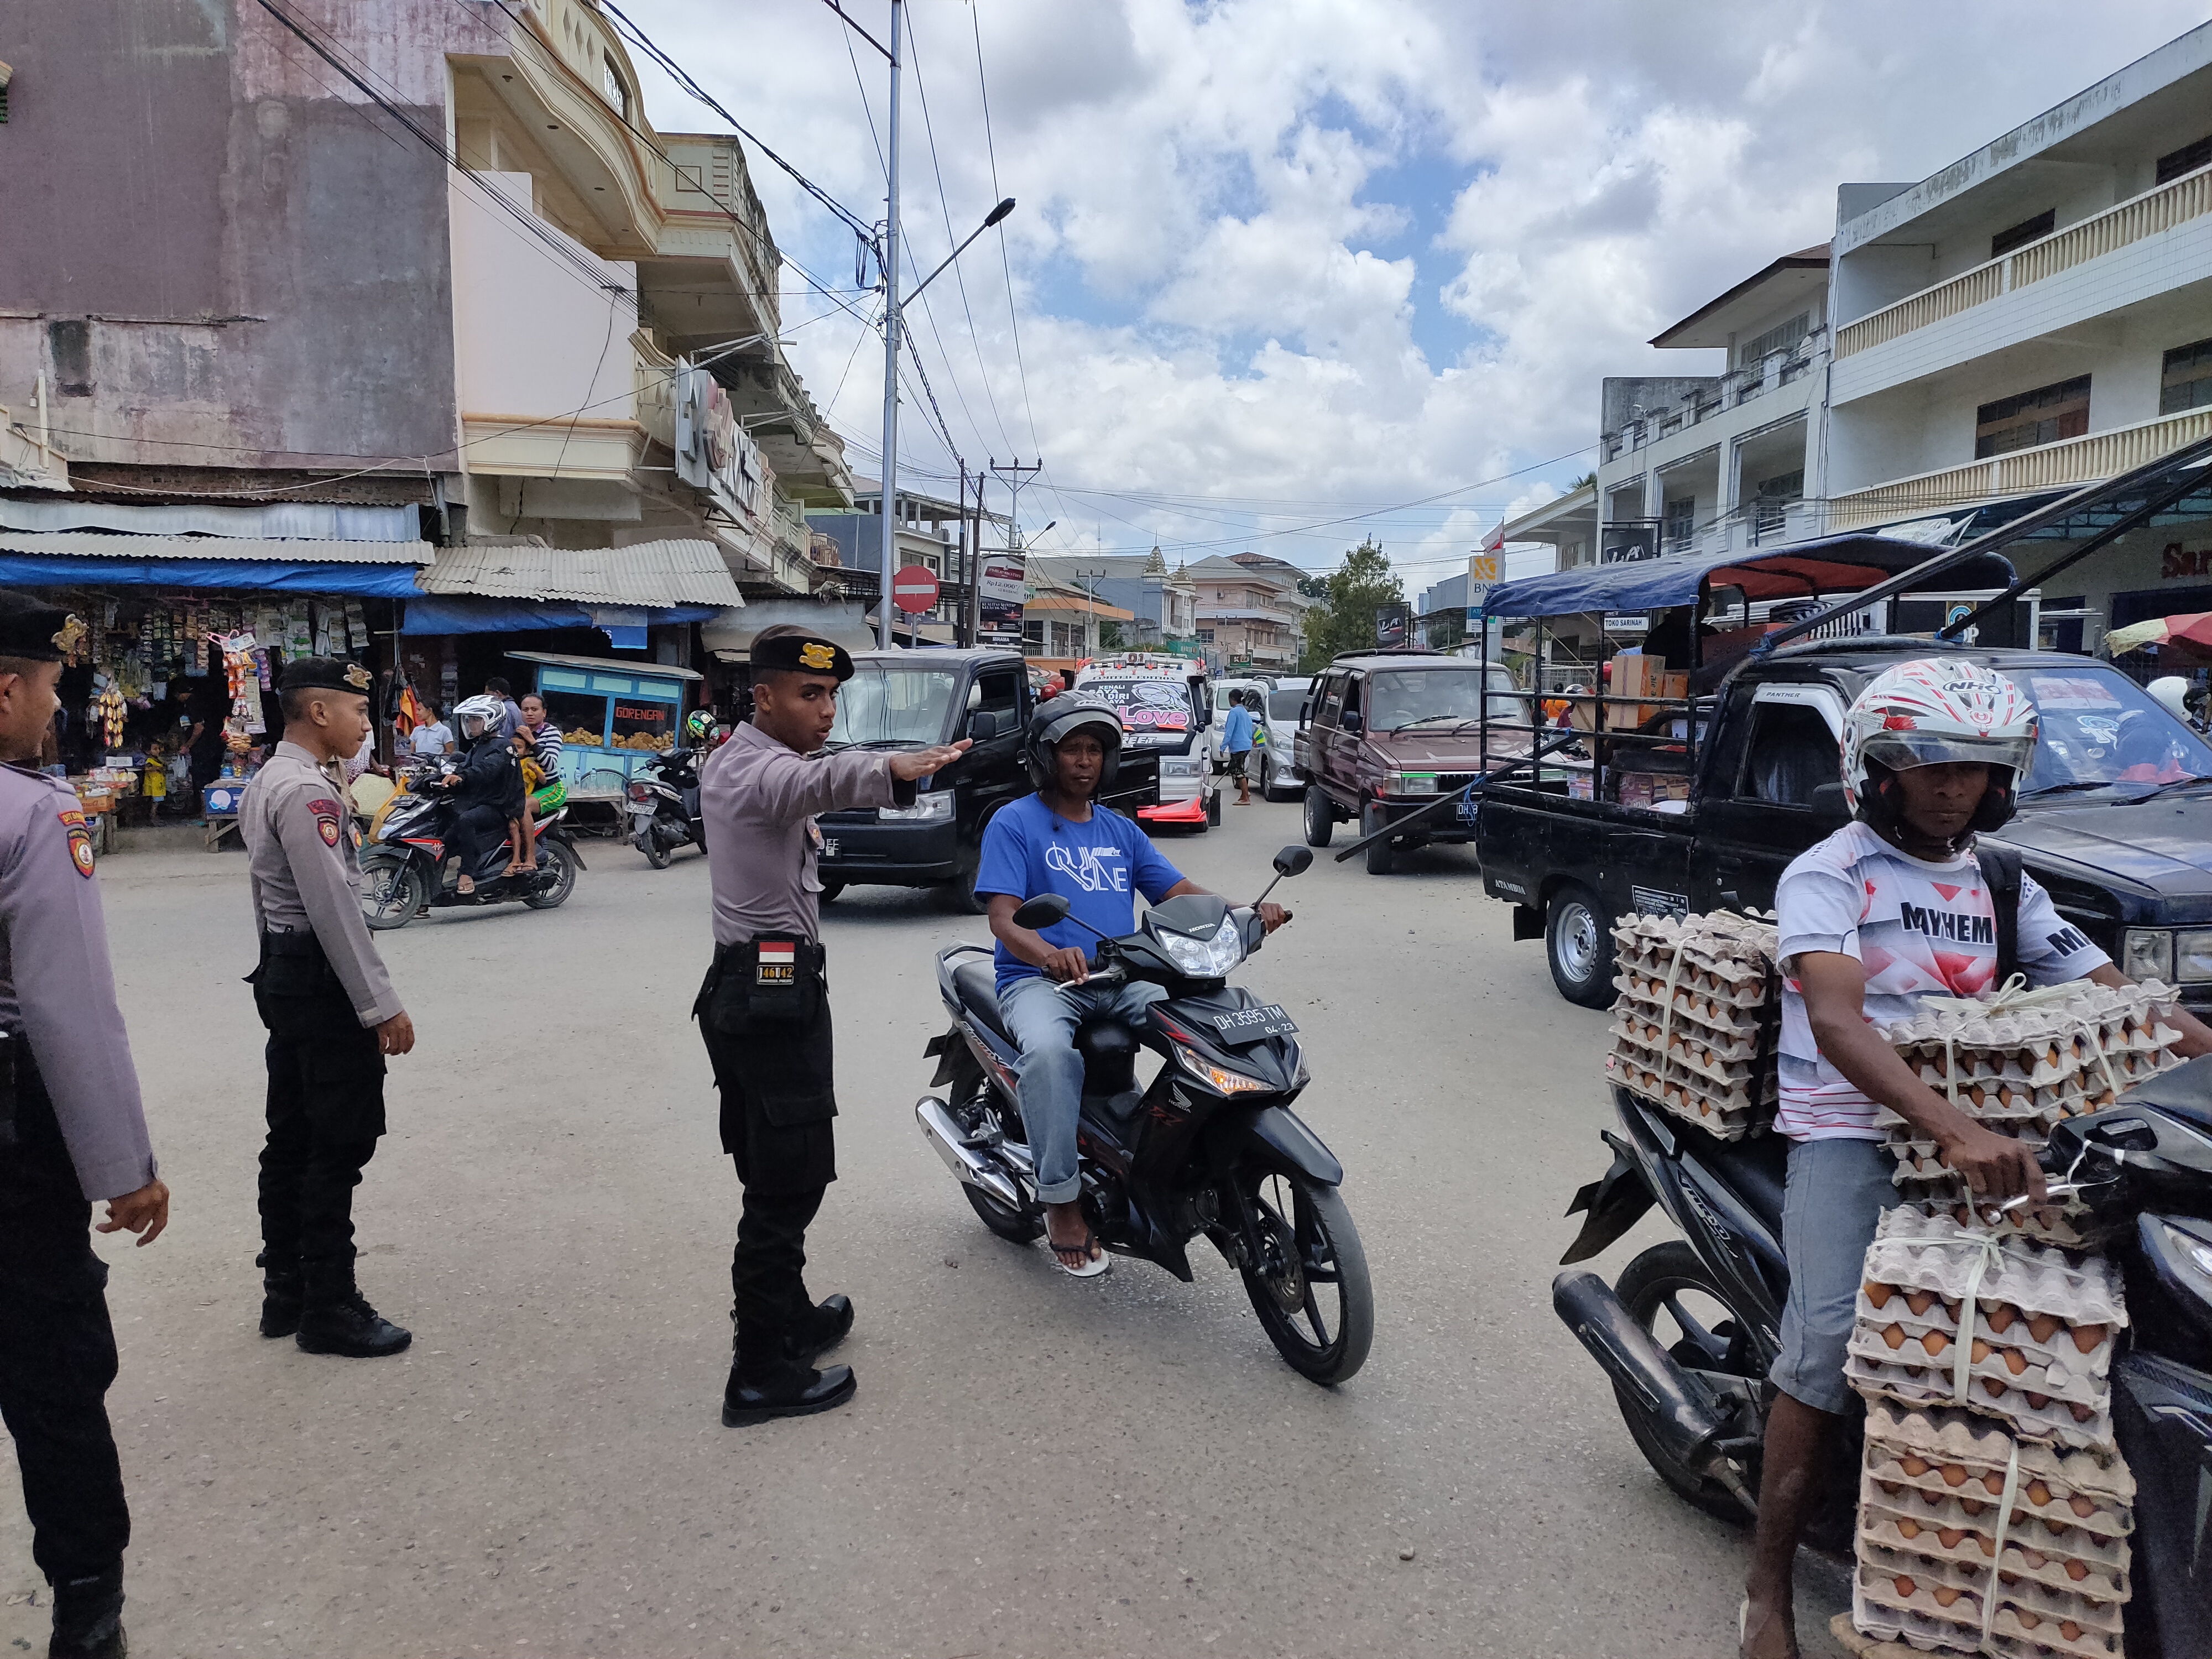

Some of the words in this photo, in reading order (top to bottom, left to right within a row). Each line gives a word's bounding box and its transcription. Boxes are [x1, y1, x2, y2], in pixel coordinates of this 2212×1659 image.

[1474, 583, 1494, 593] BN
[615, 706, 665, 721] GORENGAN
[1118, 706, 1187, 725] Love
[1458, 804, 1469, 815] DH
[1495, 879, 1526, 895] ATAMBUA
[1188, 923, 1216, 933] HONDA
[2045, 926, 2091, 957] M
[1213, 1014, 1236, 1030] DH
[1232, 1009, 1266, 1026] 3595
[1262, 1005, 1286, 1021] TM
